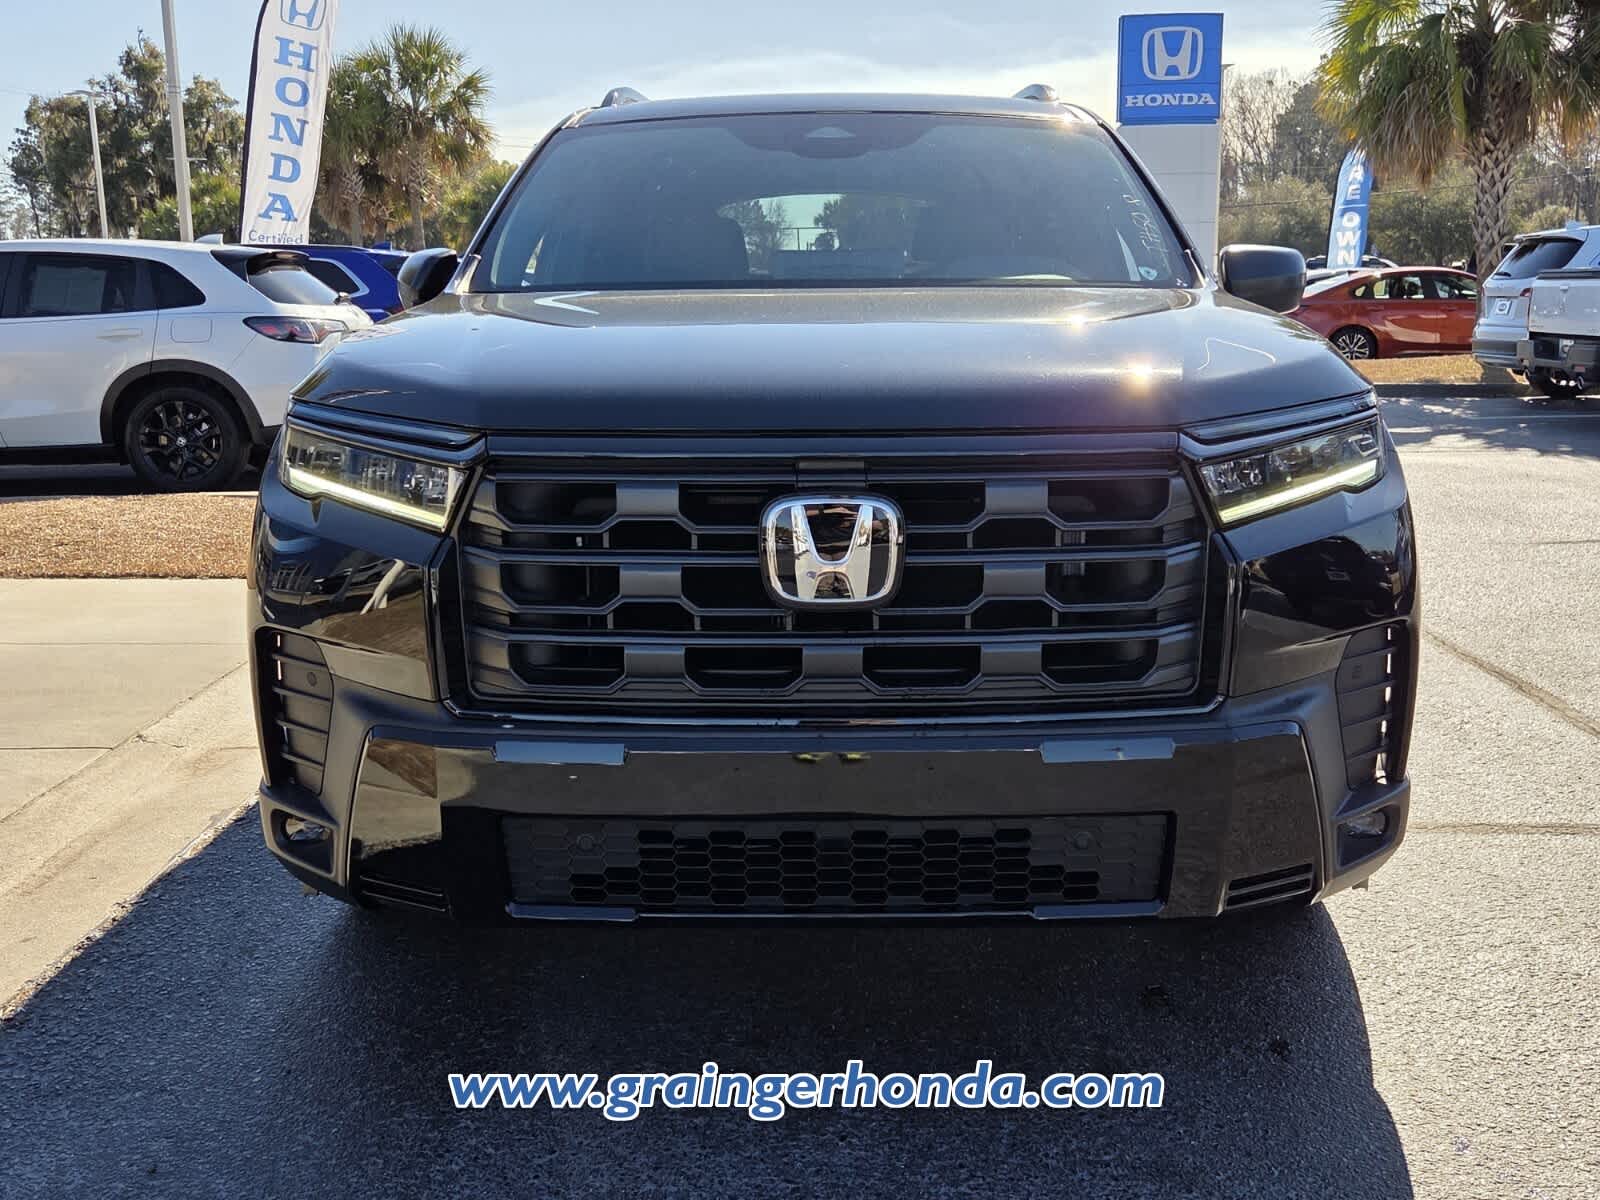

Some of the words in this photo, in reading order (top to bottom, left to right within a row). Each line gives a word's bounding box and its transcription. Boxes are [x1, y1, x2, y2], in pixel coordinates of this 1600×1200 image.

[1125, 93, 1217, 107] HONDA
[258, 35, 318, 222] HONDA
[248, 229, 304, 244] Certified
[1336, 211, 1362, 265] OWN
